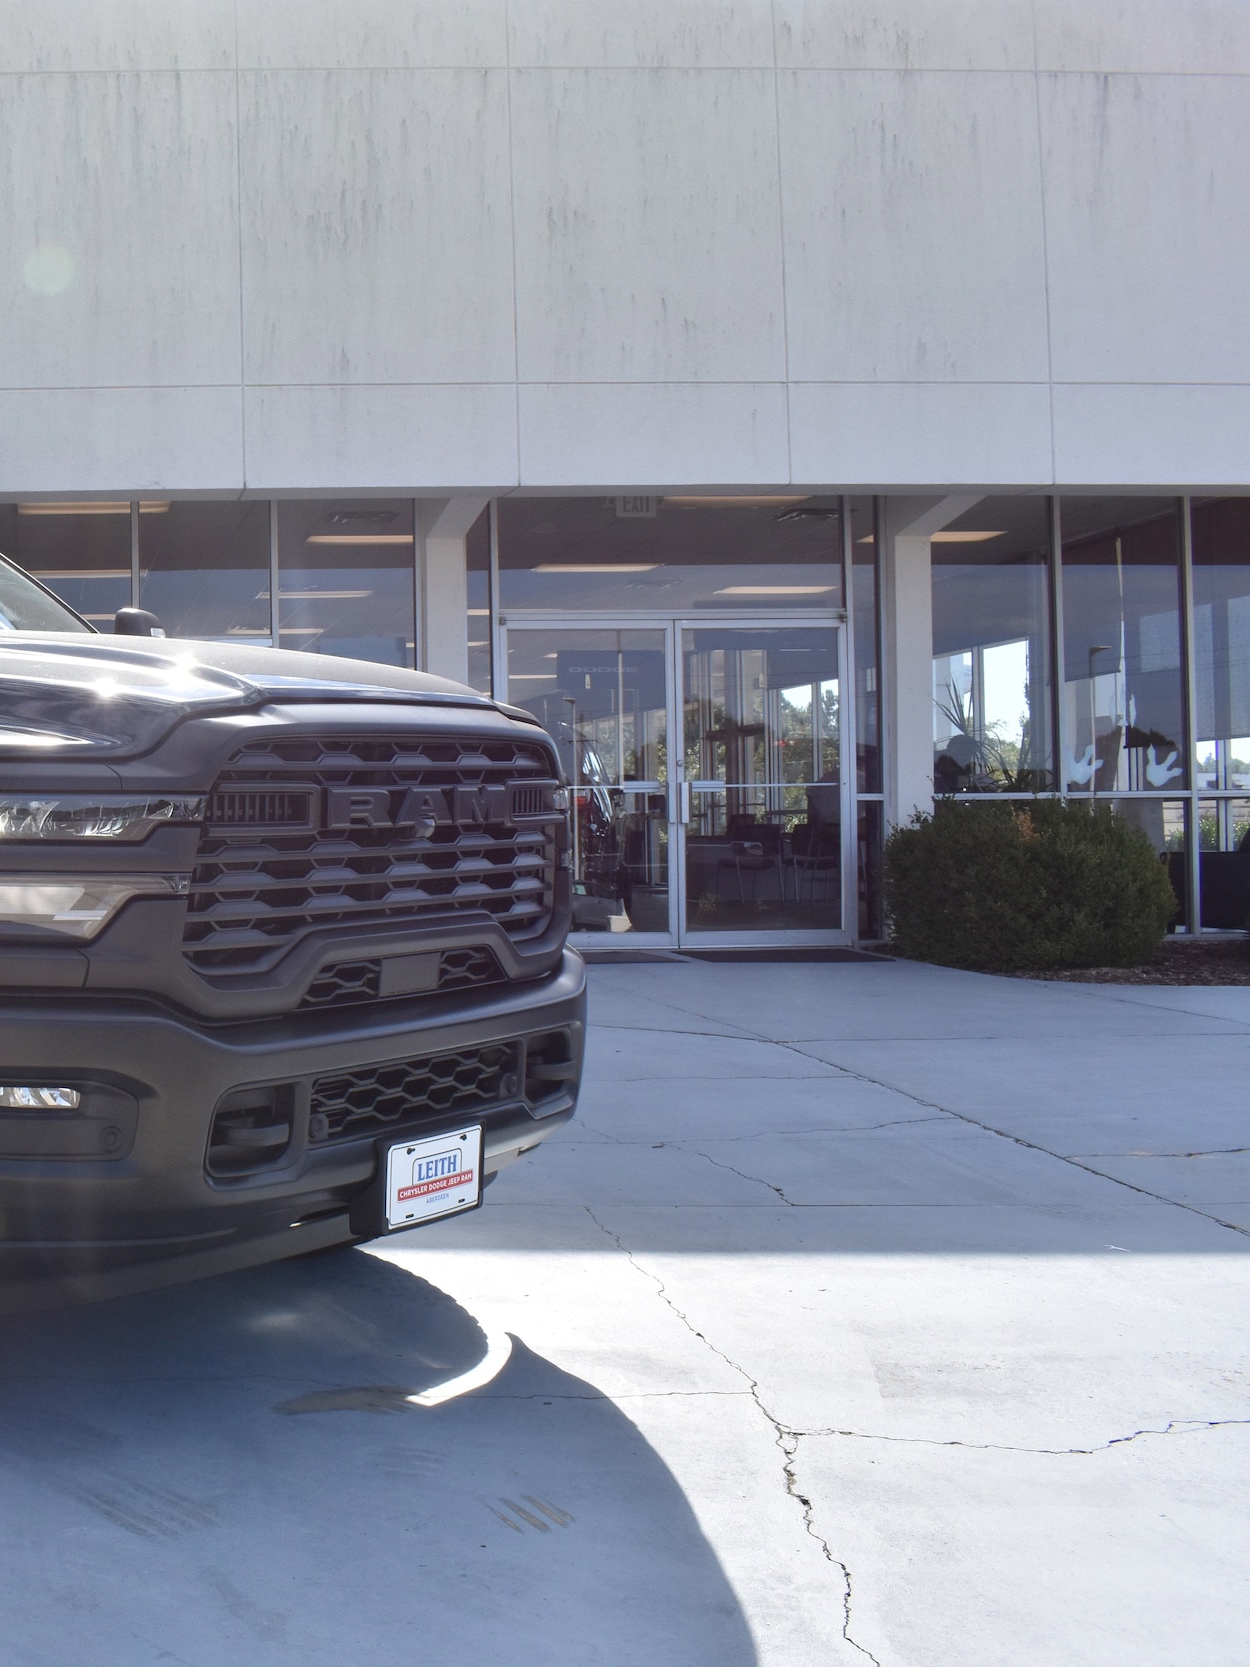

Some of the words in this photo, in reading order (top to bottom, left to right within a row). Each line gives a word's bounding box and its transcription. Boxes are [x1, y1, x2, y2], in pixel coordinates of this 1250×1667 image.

[328, 784, 506, 829] RAM
[417, 1154, 457, 1181] LEITH
[400, 1185, 428, 1198] CHRYSLER
[428, 1180, 447, 1191] DODGE
[448, 1177, 460, 1186] JEEP
[461, 1173, 472, 1181] RAM
[426, 1193, 449, 1204] ABERDEEN
